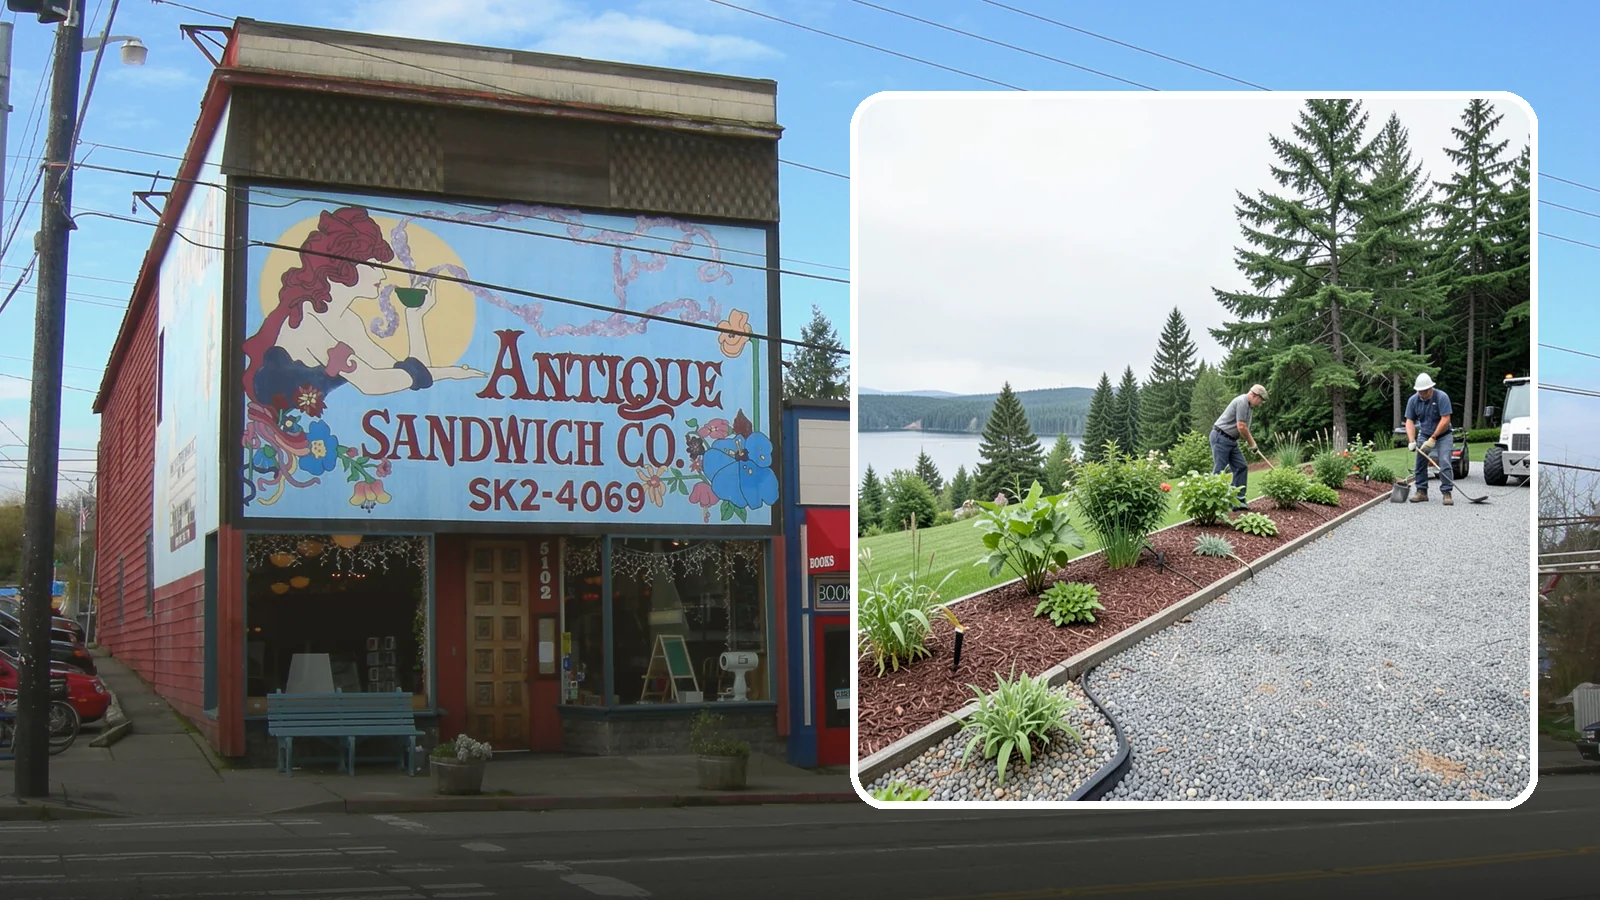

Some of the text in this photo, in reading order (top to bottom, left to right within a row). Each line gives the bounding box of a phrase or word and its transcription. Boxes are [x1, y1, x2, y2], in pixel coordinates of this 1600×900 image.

[476, 329, 723, 420] ANTIQUE
[361, 408, 685, 469] SANDWICH CO.
[468, 477, 645, 512] SK2-4069
[540, 541, 551, 600] 5102
[809, 555, 834, 569] BOOKS
